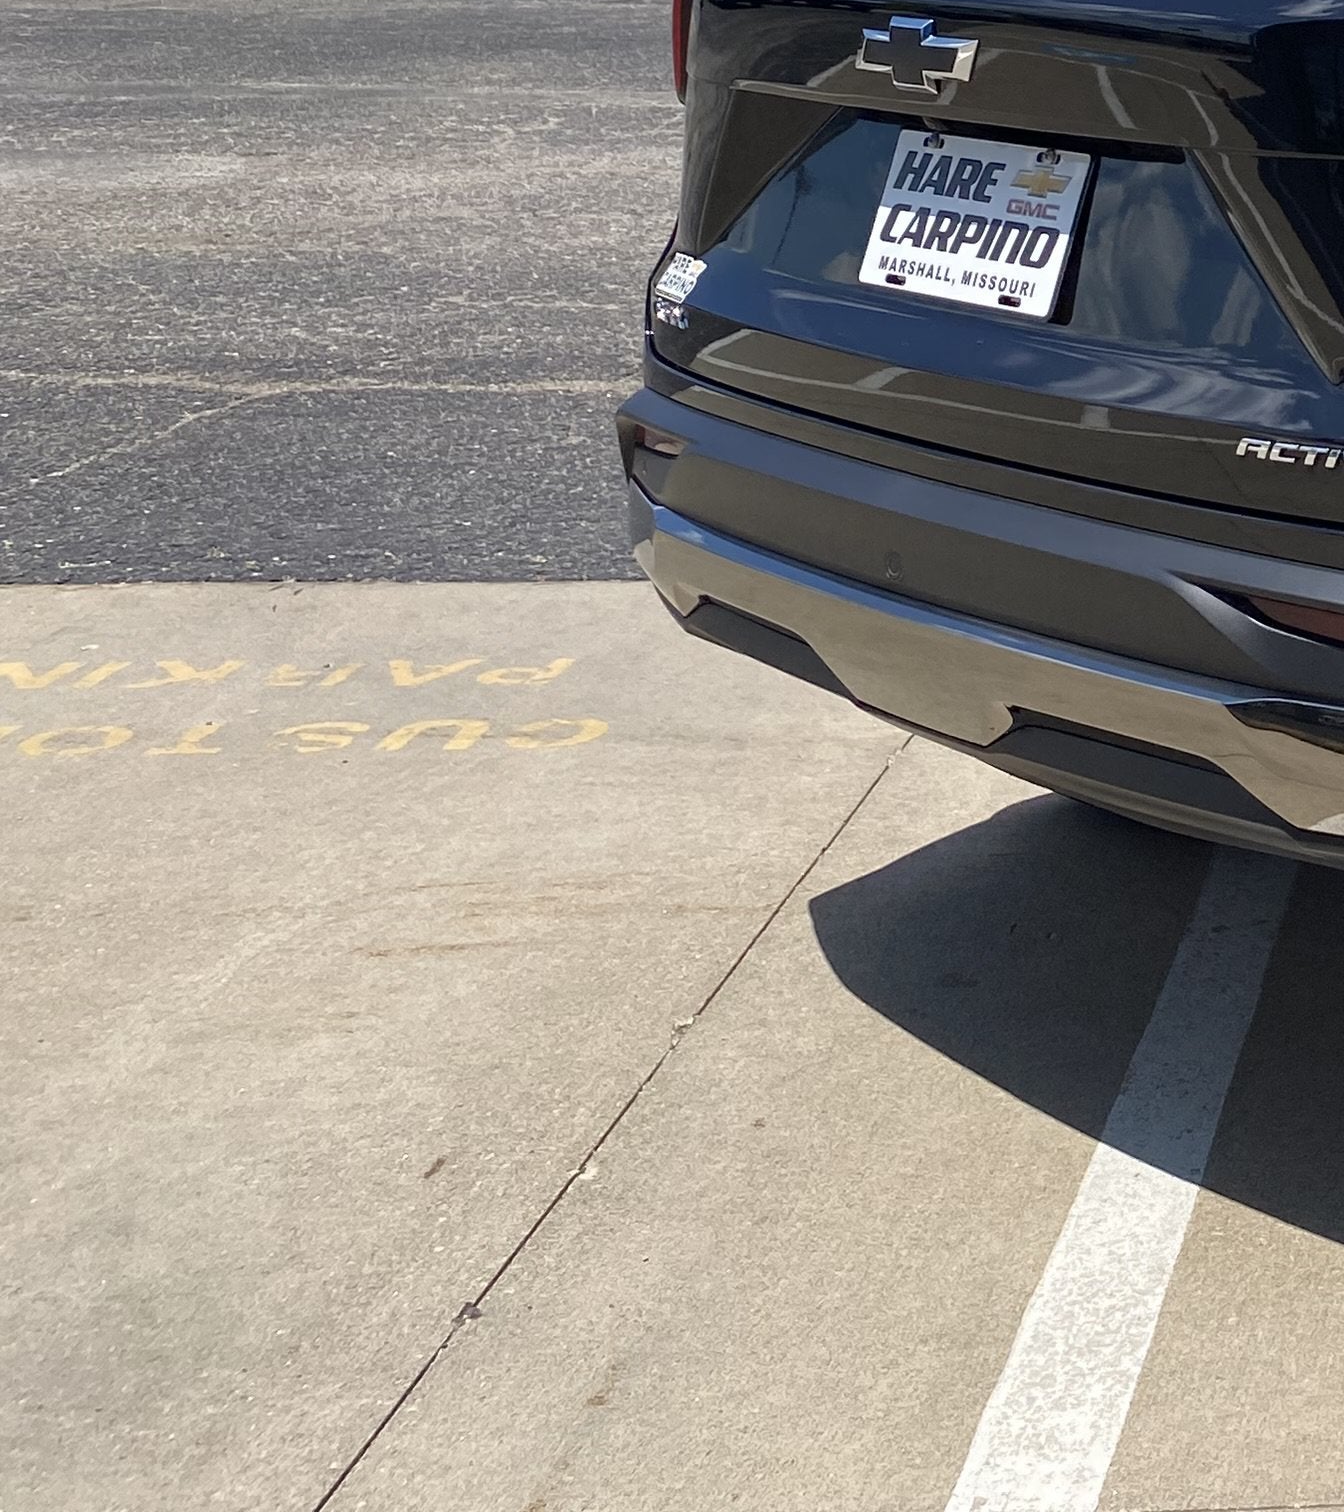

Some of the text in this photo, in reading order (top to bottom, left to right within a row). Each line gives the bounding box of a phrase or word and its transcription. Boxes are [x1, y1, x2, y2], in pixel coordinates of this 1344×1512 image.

[892, 150, 1006, 204] HARE
[1006, 198, 1060, 221] GMC
[879, 202, 1061, 270] CARPINO
[878, 255, 1036, 299] MARSHALL, MISSOURI
[0, 717, 610, 758] CUSTO
